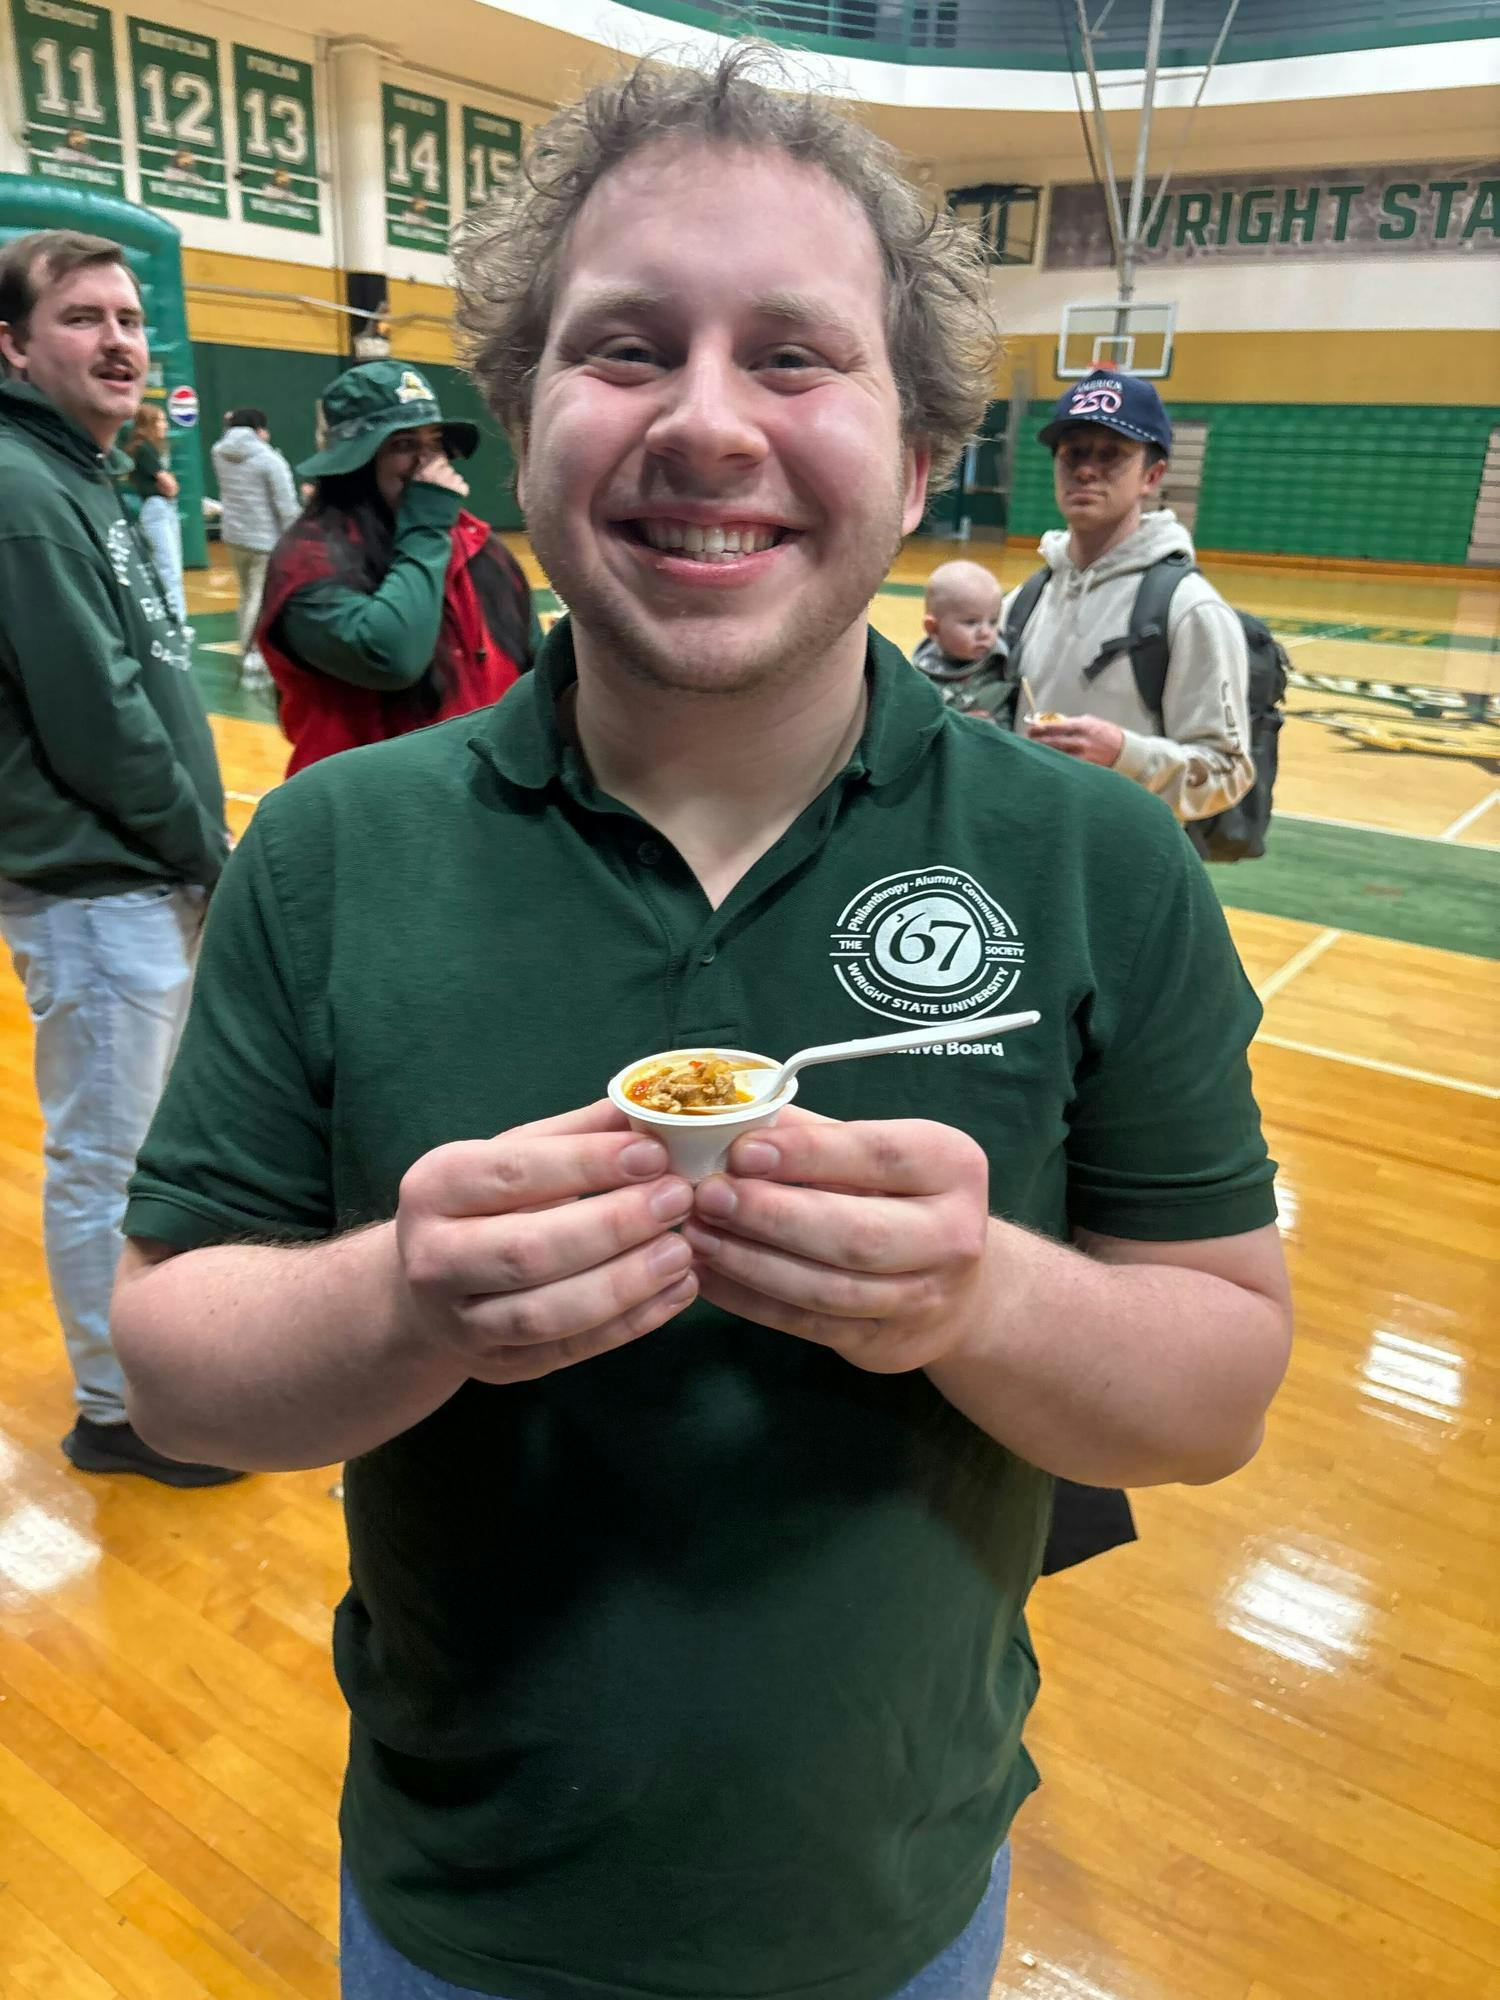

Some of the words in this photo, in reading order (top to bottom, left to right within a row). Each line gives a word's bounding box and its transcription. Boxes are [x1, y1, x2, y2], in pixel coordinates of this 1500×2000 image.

[31, 37, 106, 124] 11
[139, 63, 215, 148] 12
[243, 88, 308, 165] 13
[388, 123, 442, 194] 14
[1069, 390, 1123, 415] 250
[847, 882, 909, 932] Philanthropy
[915, 875, 959, 887] Alumni
[962, 882, 1007, 938] Community
[838, 940, 864, 950] THE
[985, 946, 1025, 957] SOCIETY
[847, 962, 893, 1004] WRIGHT
[891, 998, 940, 1015] STATE
[941, 967, 1009, 1014] UNIVERSITY
[946, 1041, 1004, 1056] Board
